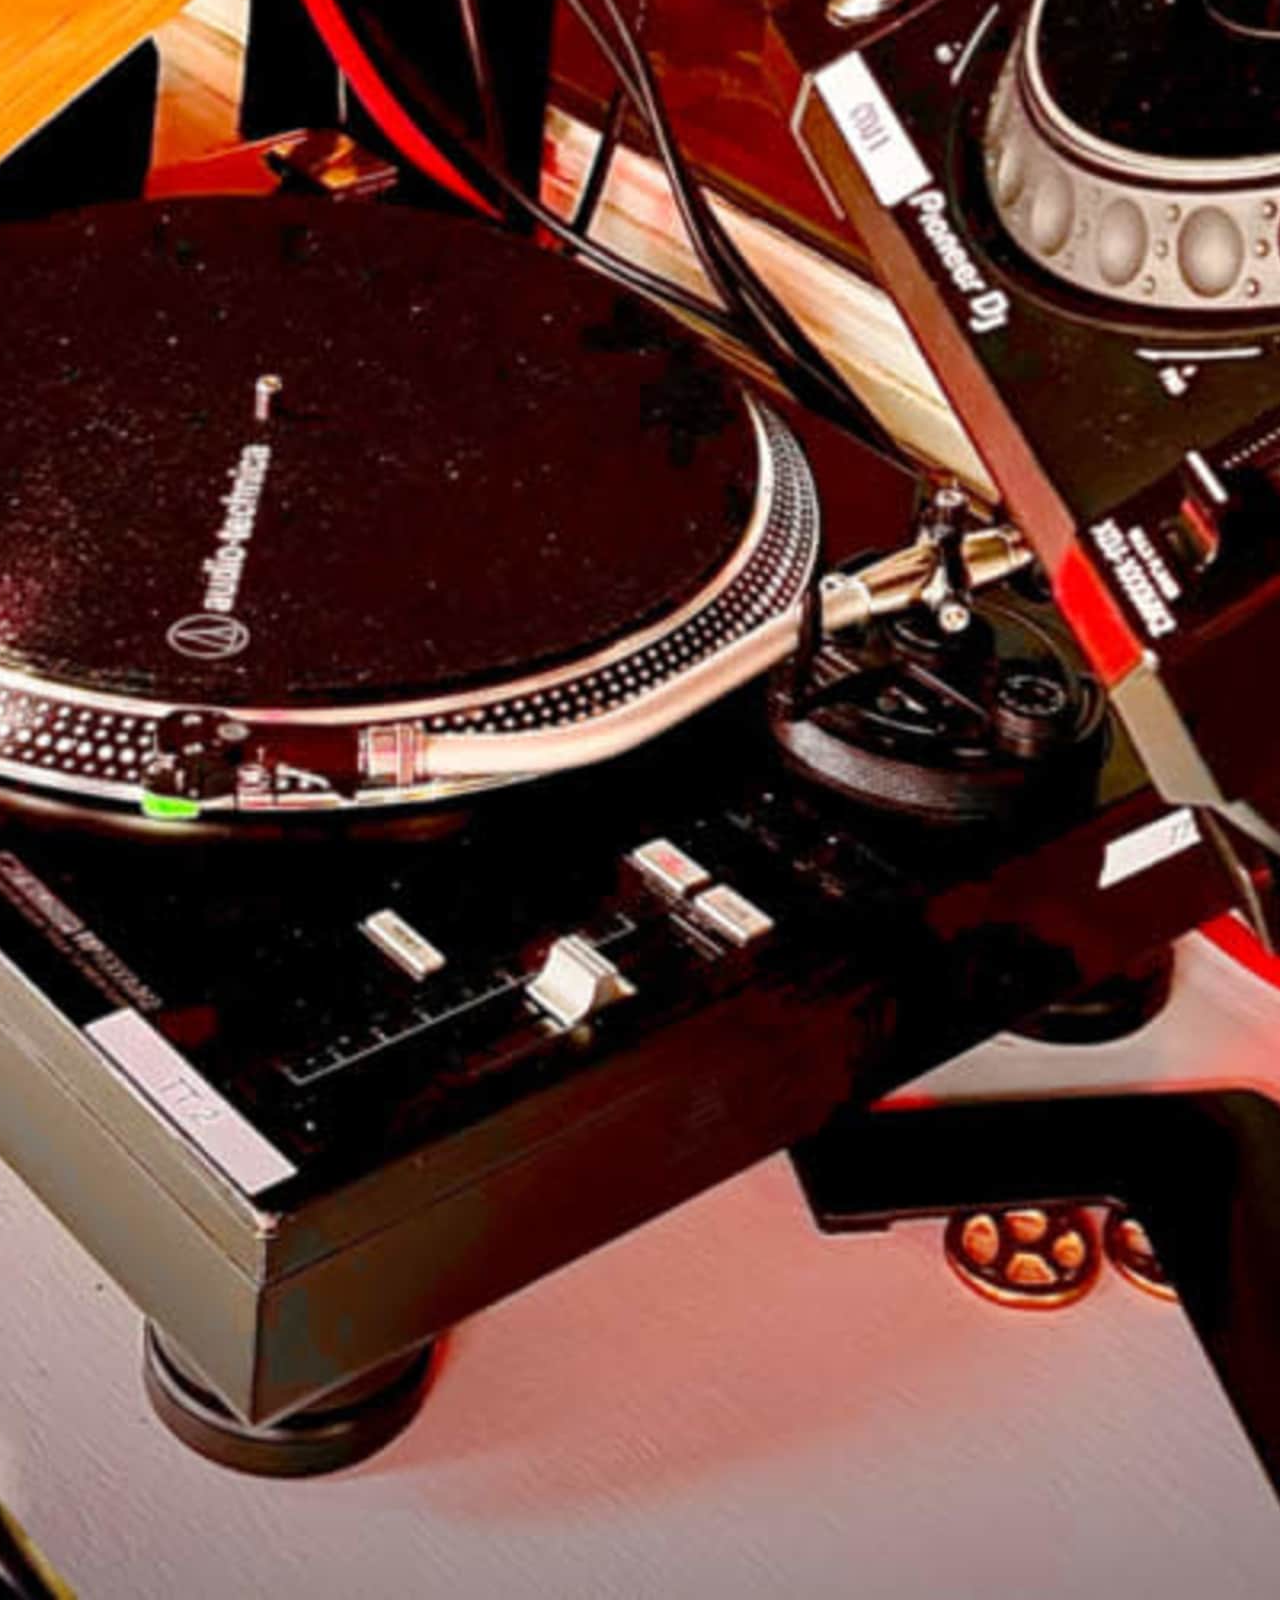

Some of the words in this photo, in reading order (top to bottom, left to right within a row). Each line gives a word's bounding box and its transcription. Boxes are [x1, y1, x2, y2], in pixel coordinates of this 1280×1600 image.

[912, 190, 987, 296] Pioneer
[968, 290, 1010, 332] DJ
[203, 444, 271, 612] audio-technica
